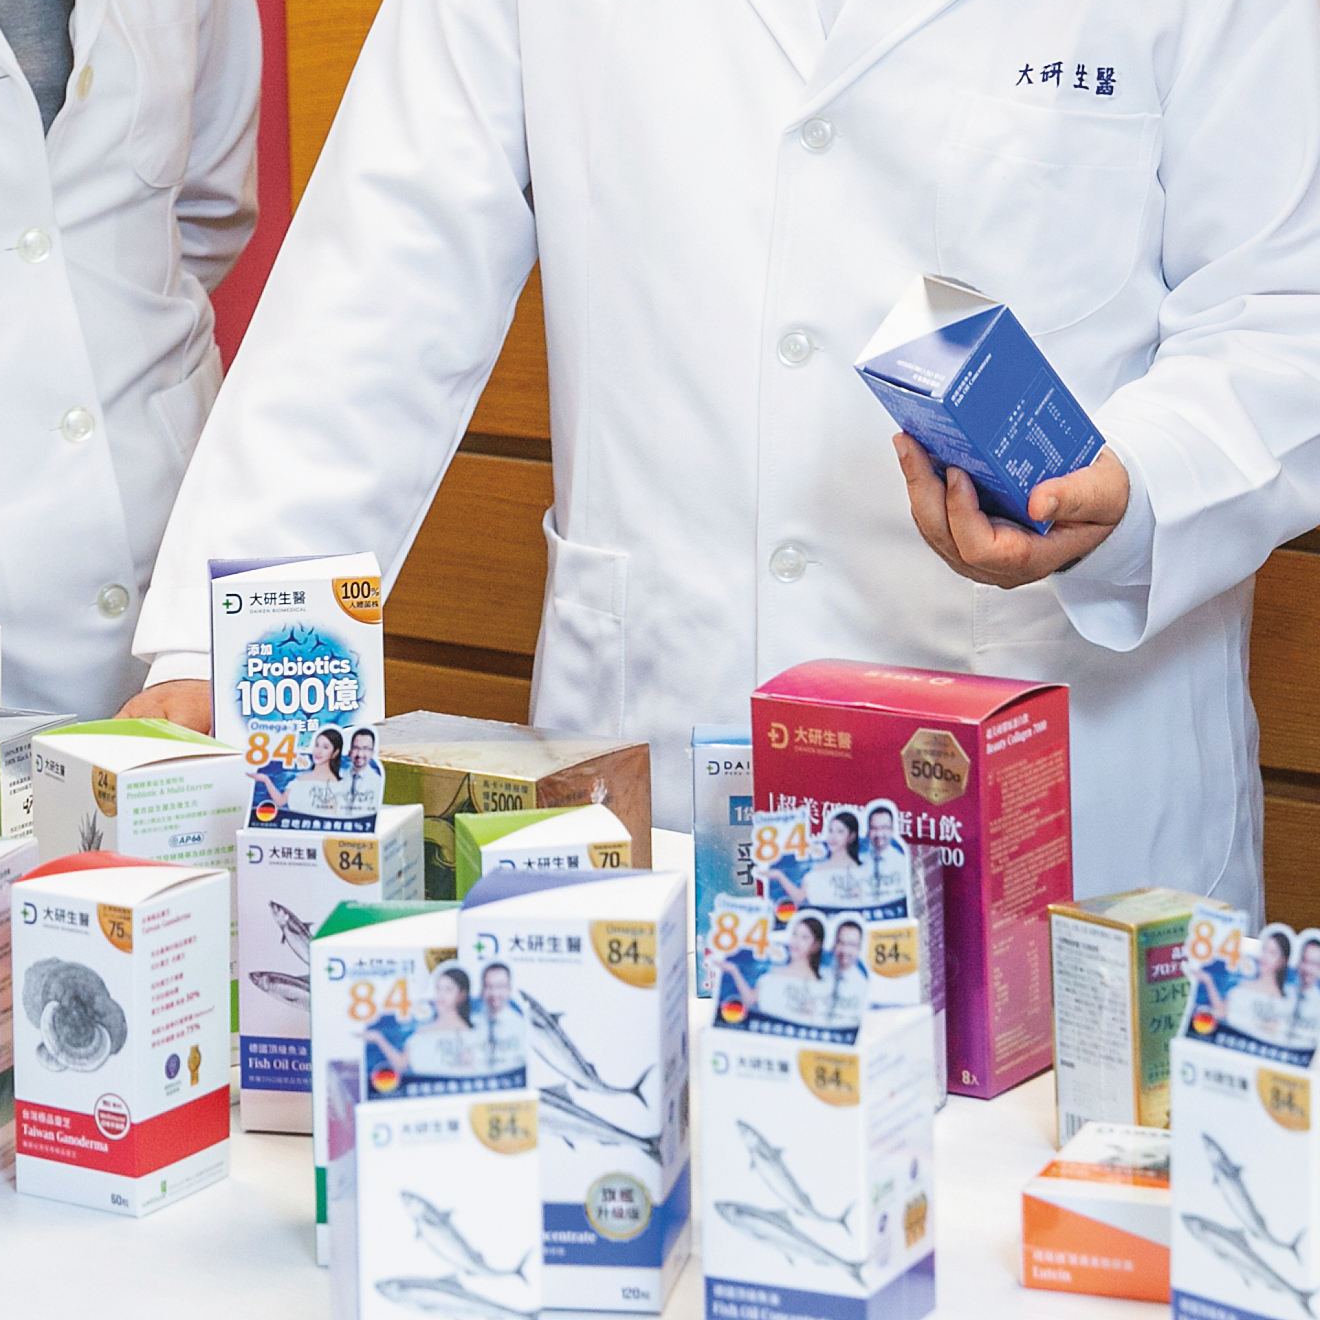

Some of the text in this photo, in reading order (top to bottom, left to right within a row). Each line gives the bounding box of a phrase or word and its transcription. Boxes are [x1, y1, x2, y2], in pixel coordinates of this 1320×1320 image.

[1016, 61, 1116, 95] 大研生醫
[250, 592, 306, 606] 大研生醫
[342, 581, 379, 599] 100%
[247, 644, 273, 656] 添加
[247, 656, 350, 676] Probiotics
[237, 678, 359, 715] 1000億
[794, 726, 852, 749] 大研生醫
[44, 759, 65, 777] 大研生醫
[127, 790, 157, 800] Probiotic
[179, 835, 201, 844] AP66
[269, 846, 317, 860] 大研生醫
[523, 855, 579, 869] 大研生醫
[43, 908, 90, 927] 大研生醫
[509, 934, 582, 952] 大研生醫
[248, 1058, 289, 1070] Fish Oil
[22, 1123, 54, 1142] Taiwan
[56, 1131, 108, 1153] Ganoderma
[543, 1231, 597, 1244] centrate
